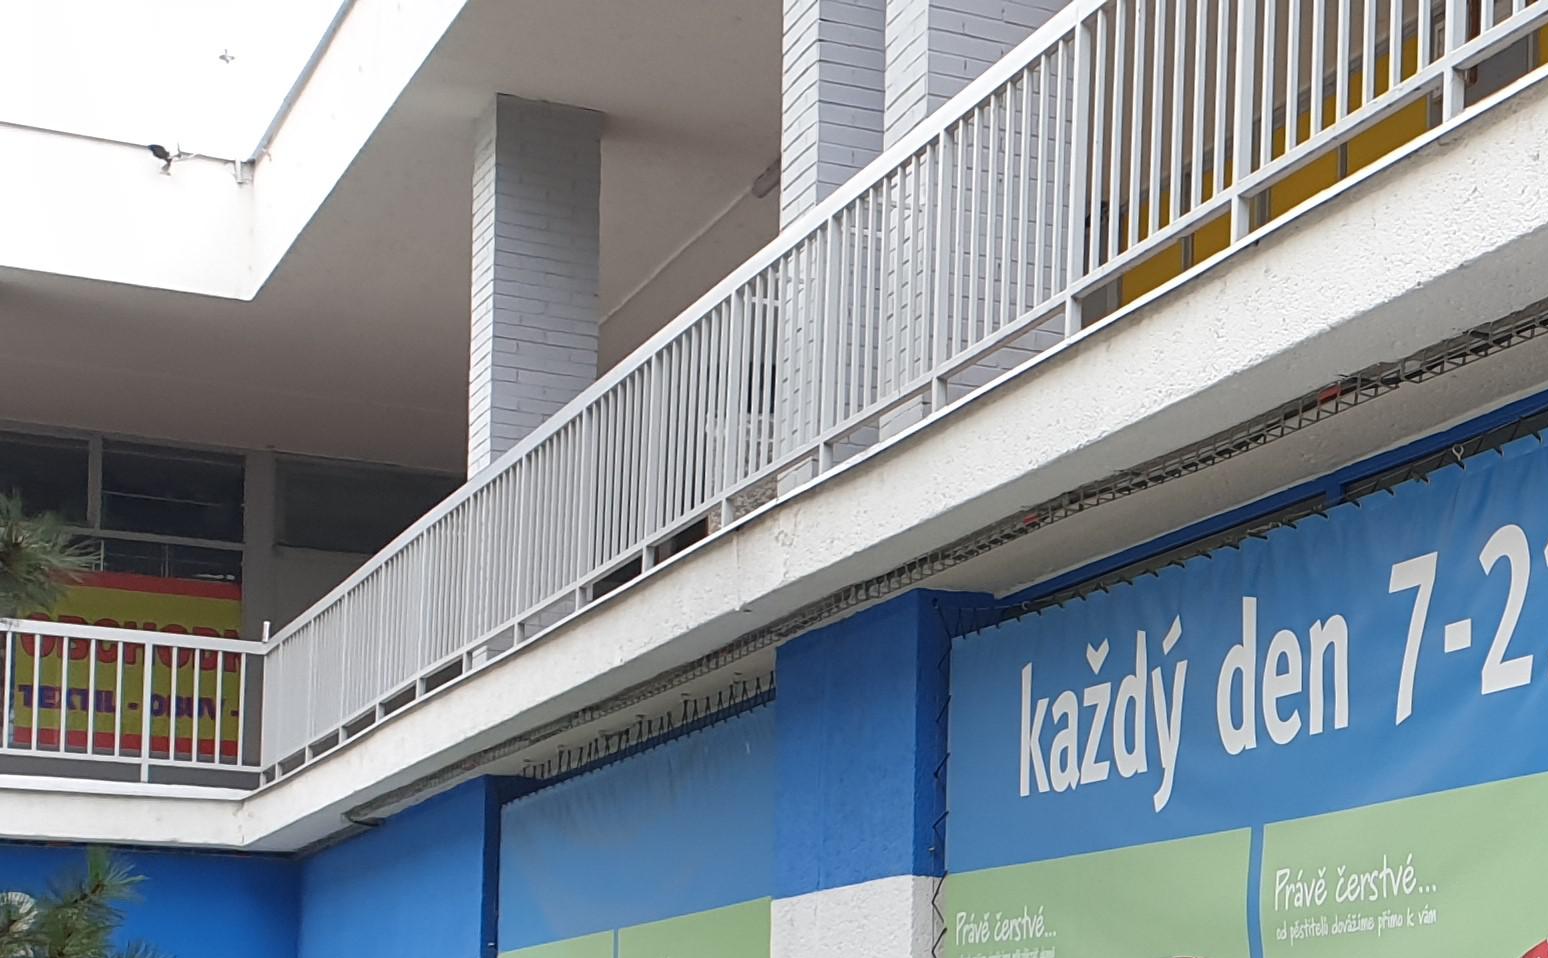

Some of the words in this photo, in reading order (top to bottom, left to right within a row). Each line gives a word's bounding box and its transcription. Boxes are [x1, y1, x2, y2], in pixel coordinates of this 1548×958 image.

[1019, 615, 1188, 812] každý
[1216, 596, 1349, 755] den
[1274, 866, 1328, 911] Právě
[1335, 853, 1437, 903] čerstvé...
[955, 911, 991, 945] Právě
[1276, 920, 1287, 940] od
[1406, 907, 1415, 926] k
[1418, 904, 1437, 925] vám
